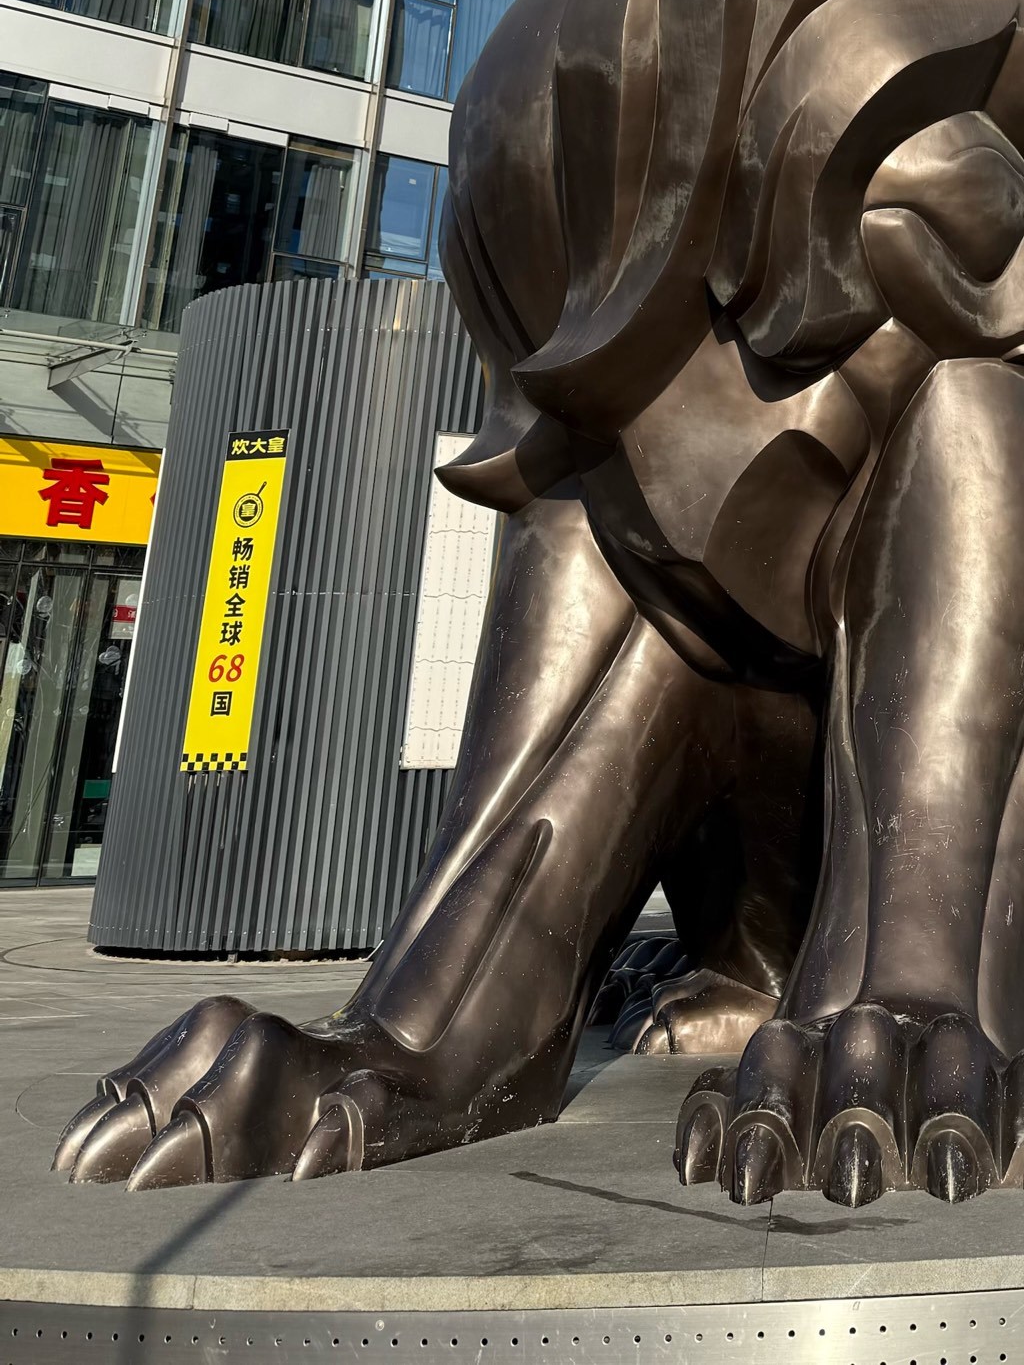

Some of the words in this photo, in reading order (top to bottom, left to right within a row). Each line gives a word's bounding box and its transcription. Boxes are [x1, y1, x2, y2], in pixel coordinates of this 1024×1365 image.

[231, 437, 285, 455] 炊大皇
[38, 458, 157, 529] 香
